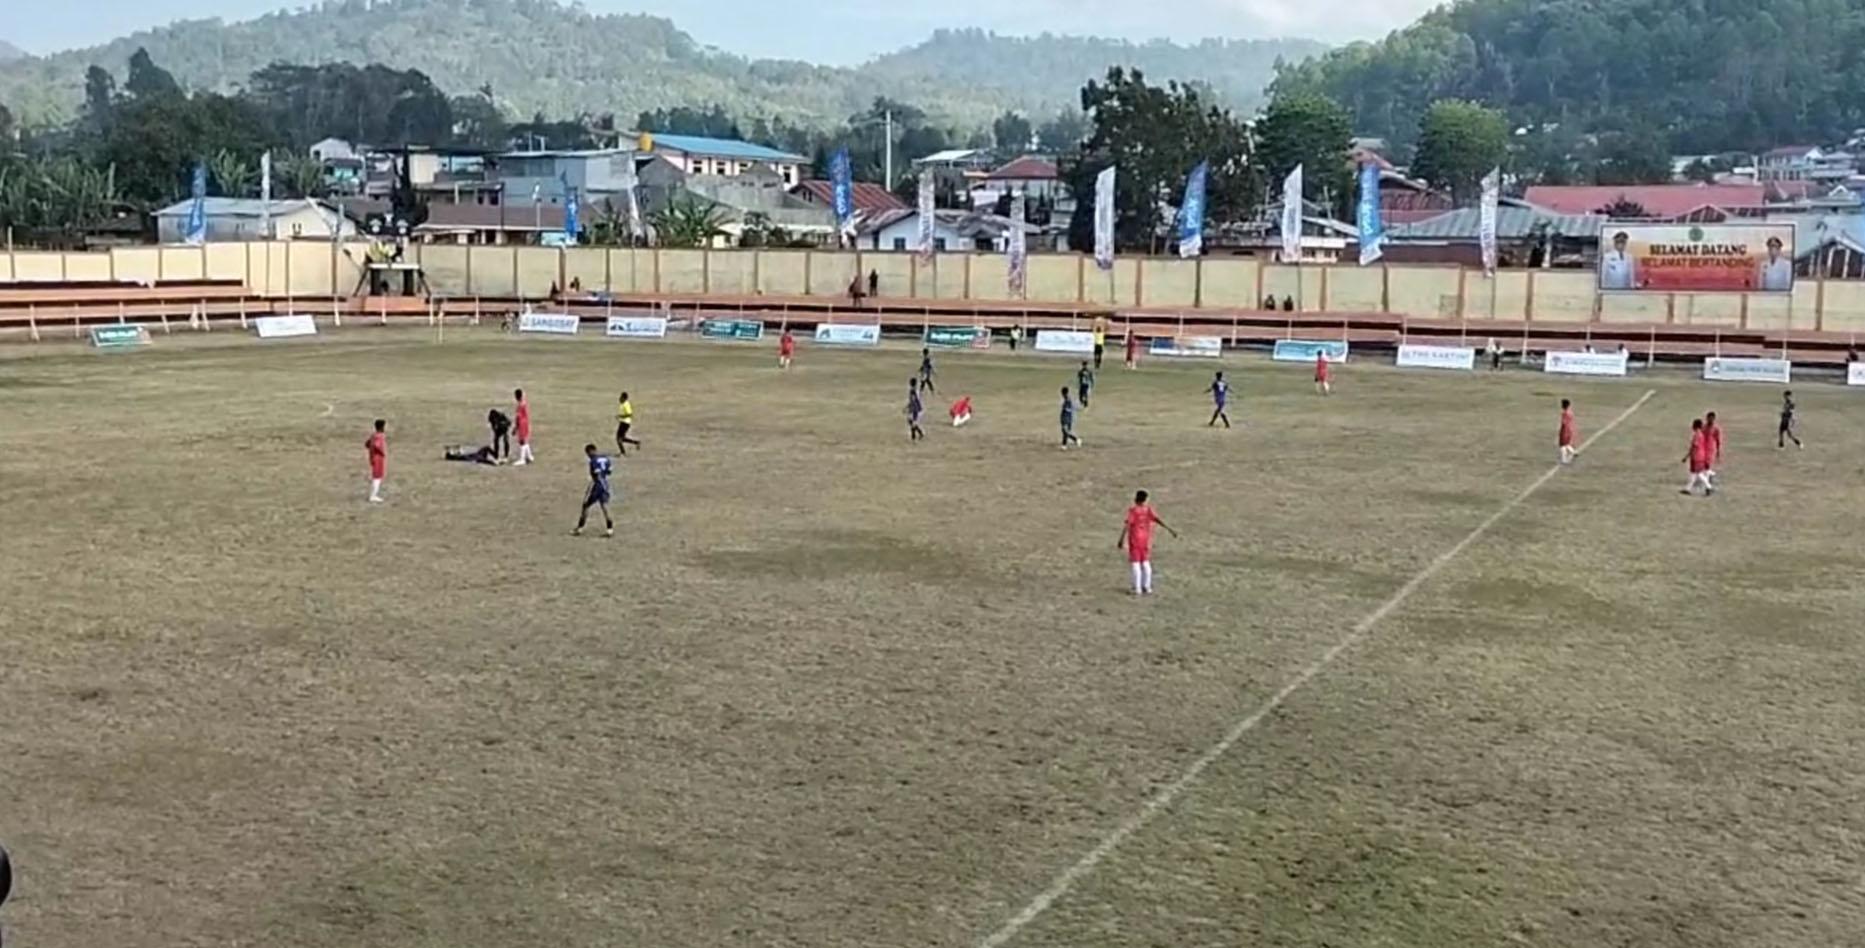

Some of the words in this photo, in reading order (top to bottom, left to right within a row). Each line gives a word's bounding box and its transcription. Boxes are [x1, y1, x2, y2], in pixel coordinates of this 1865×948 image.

[1649, 244, 1699, 256] SELAMAT
[1701, 244, 1747, 256] DATANG
[1641, 257, 1687, 268] SELAMAT
